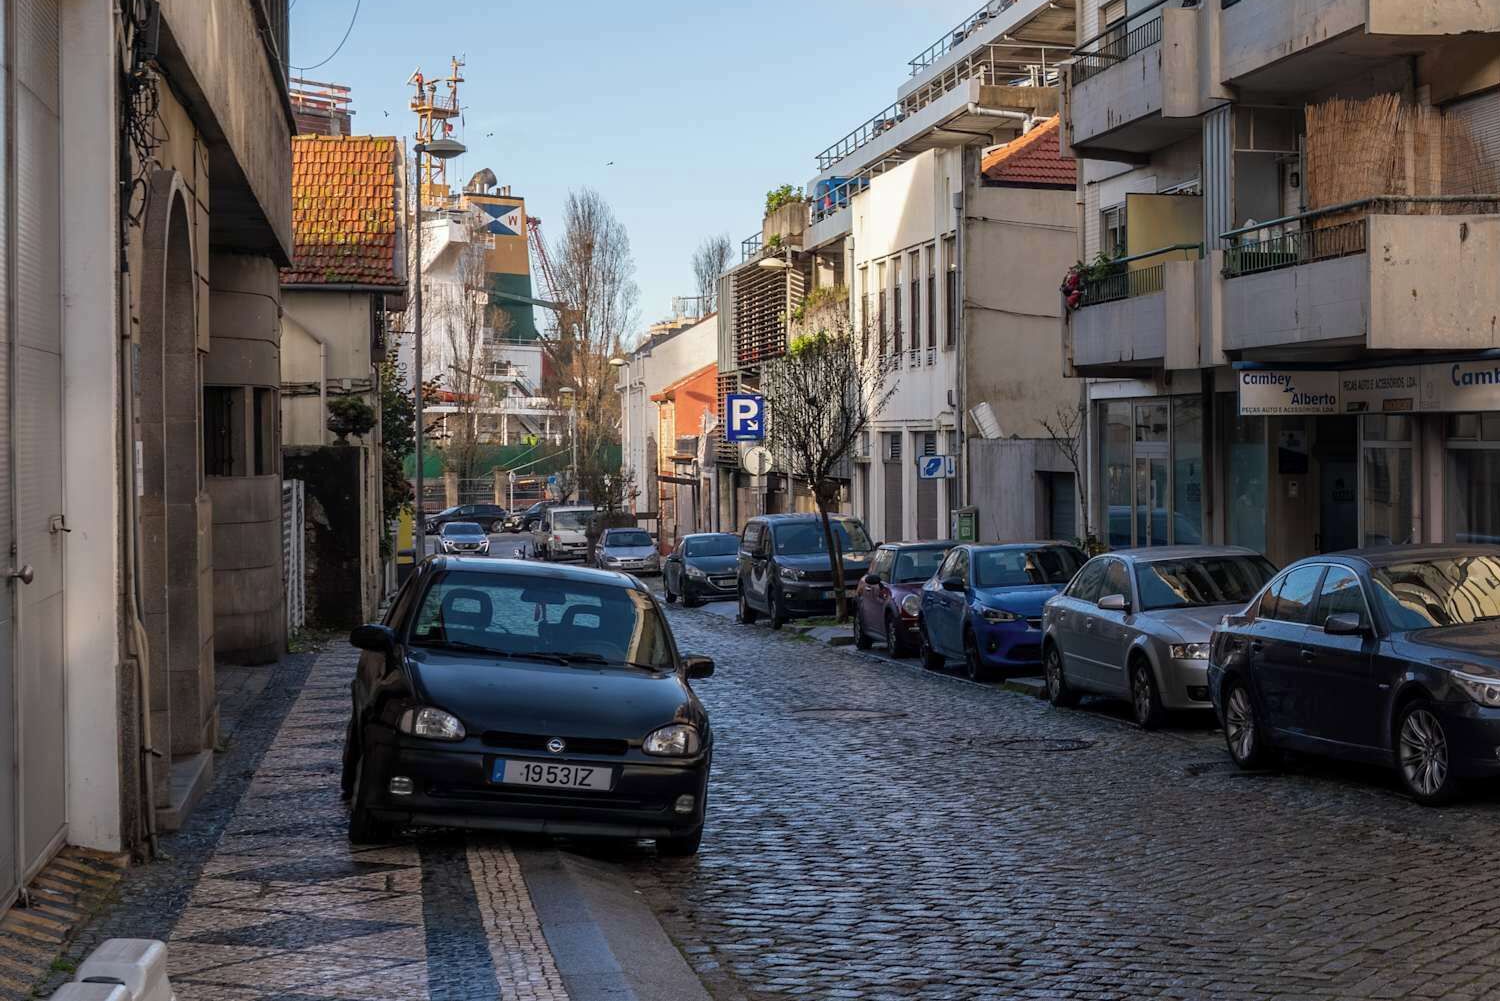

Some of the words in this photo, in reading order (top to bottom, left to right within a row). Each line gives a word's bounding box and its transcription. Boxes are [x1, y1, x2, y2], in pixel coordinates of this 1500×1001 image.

[1243, 372, 1291, 387] Cambey
[1291, 392, 1336, 405] Alberto
[733, 399, 758, 430] P
